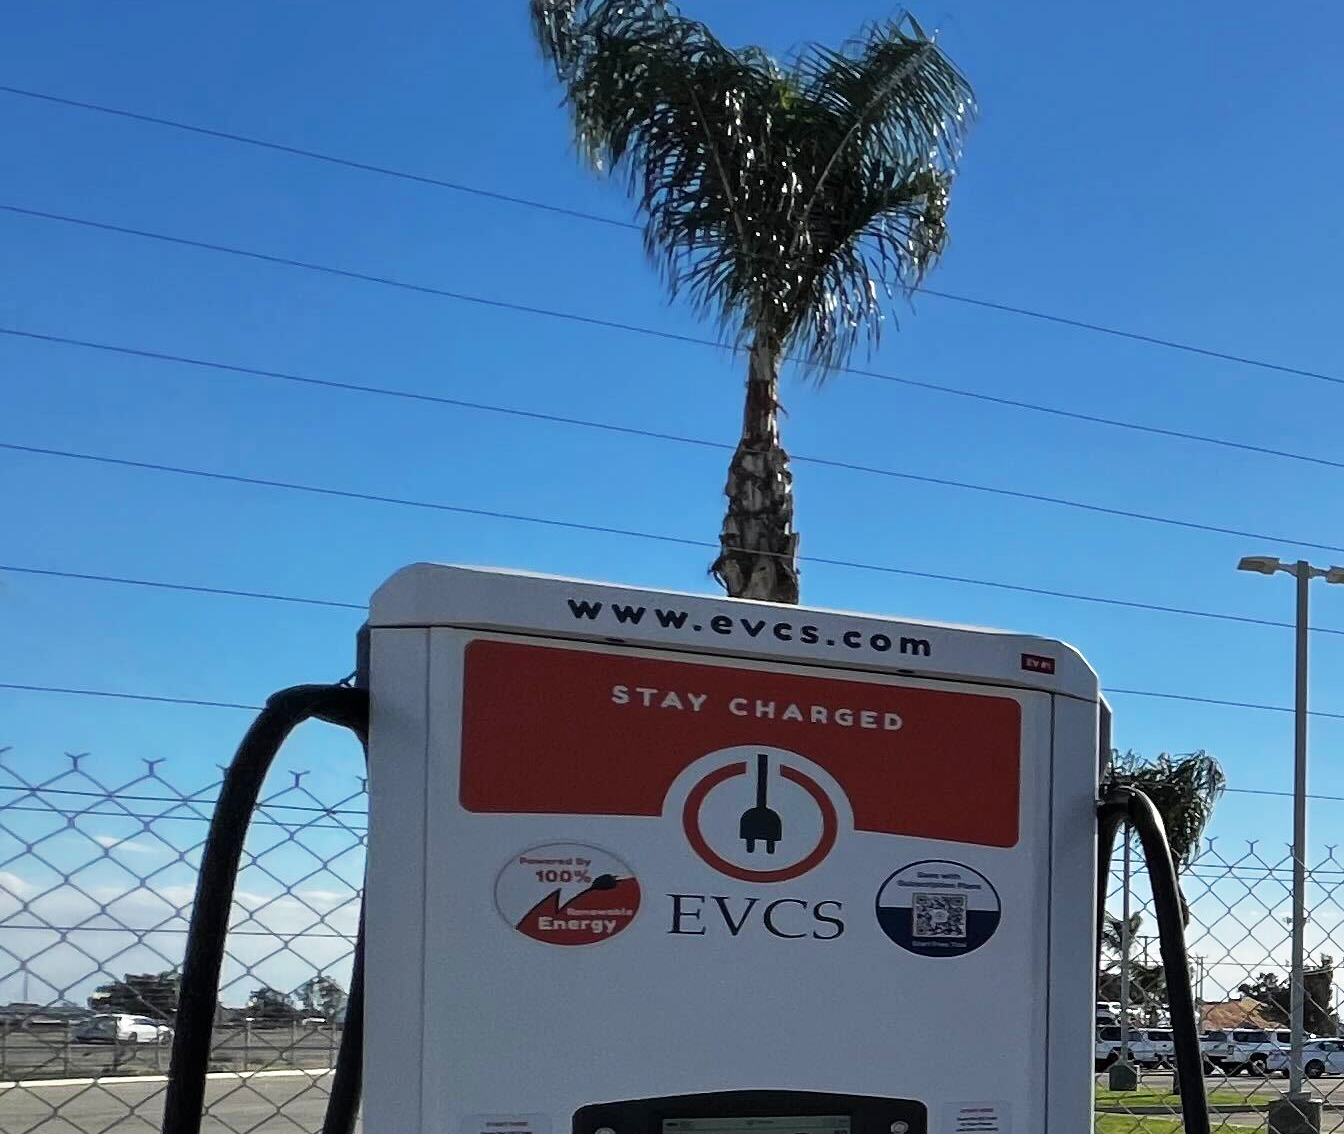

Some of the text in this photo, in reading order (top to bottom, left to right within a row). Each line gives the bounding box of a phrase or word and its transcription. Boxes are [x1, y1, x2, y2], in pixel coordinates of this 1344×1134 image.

[567, 598, 932, 656] www.evcs.com
[611, 684, 904, 731] STAY CHARGED
[535, 869, 592, 883] 100%
[537, 916, 616, 935] Energy
[667, 892, 845, 940] EVCS
